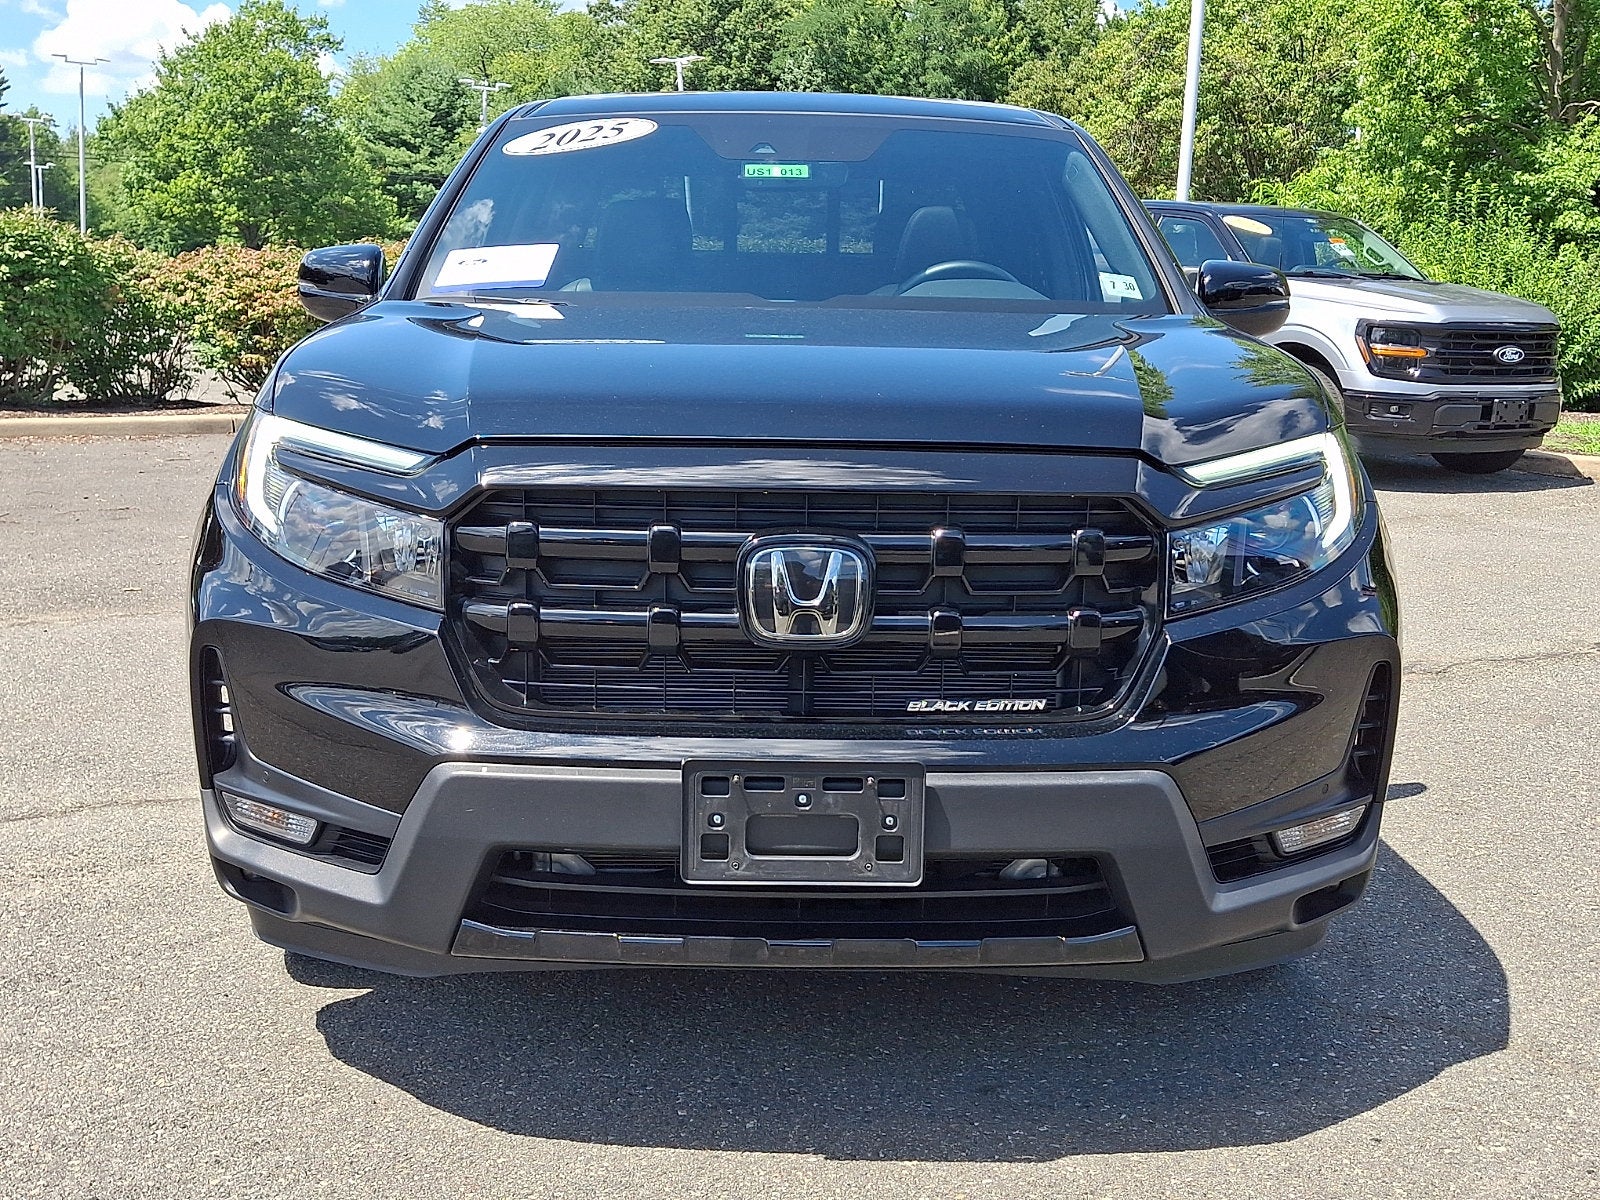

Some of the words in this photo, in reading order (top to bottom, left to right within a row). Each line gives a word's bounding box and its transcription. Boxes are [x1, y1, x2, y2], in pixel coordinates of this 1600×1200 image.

[531, 121, 629, 151] 2025
[746, 168, 802, 176] US1013
[1122, 281, 1136, 291] 30
[906, 699, 970, 712] BLACK
[974, 699, 1047, 712] EDITION
